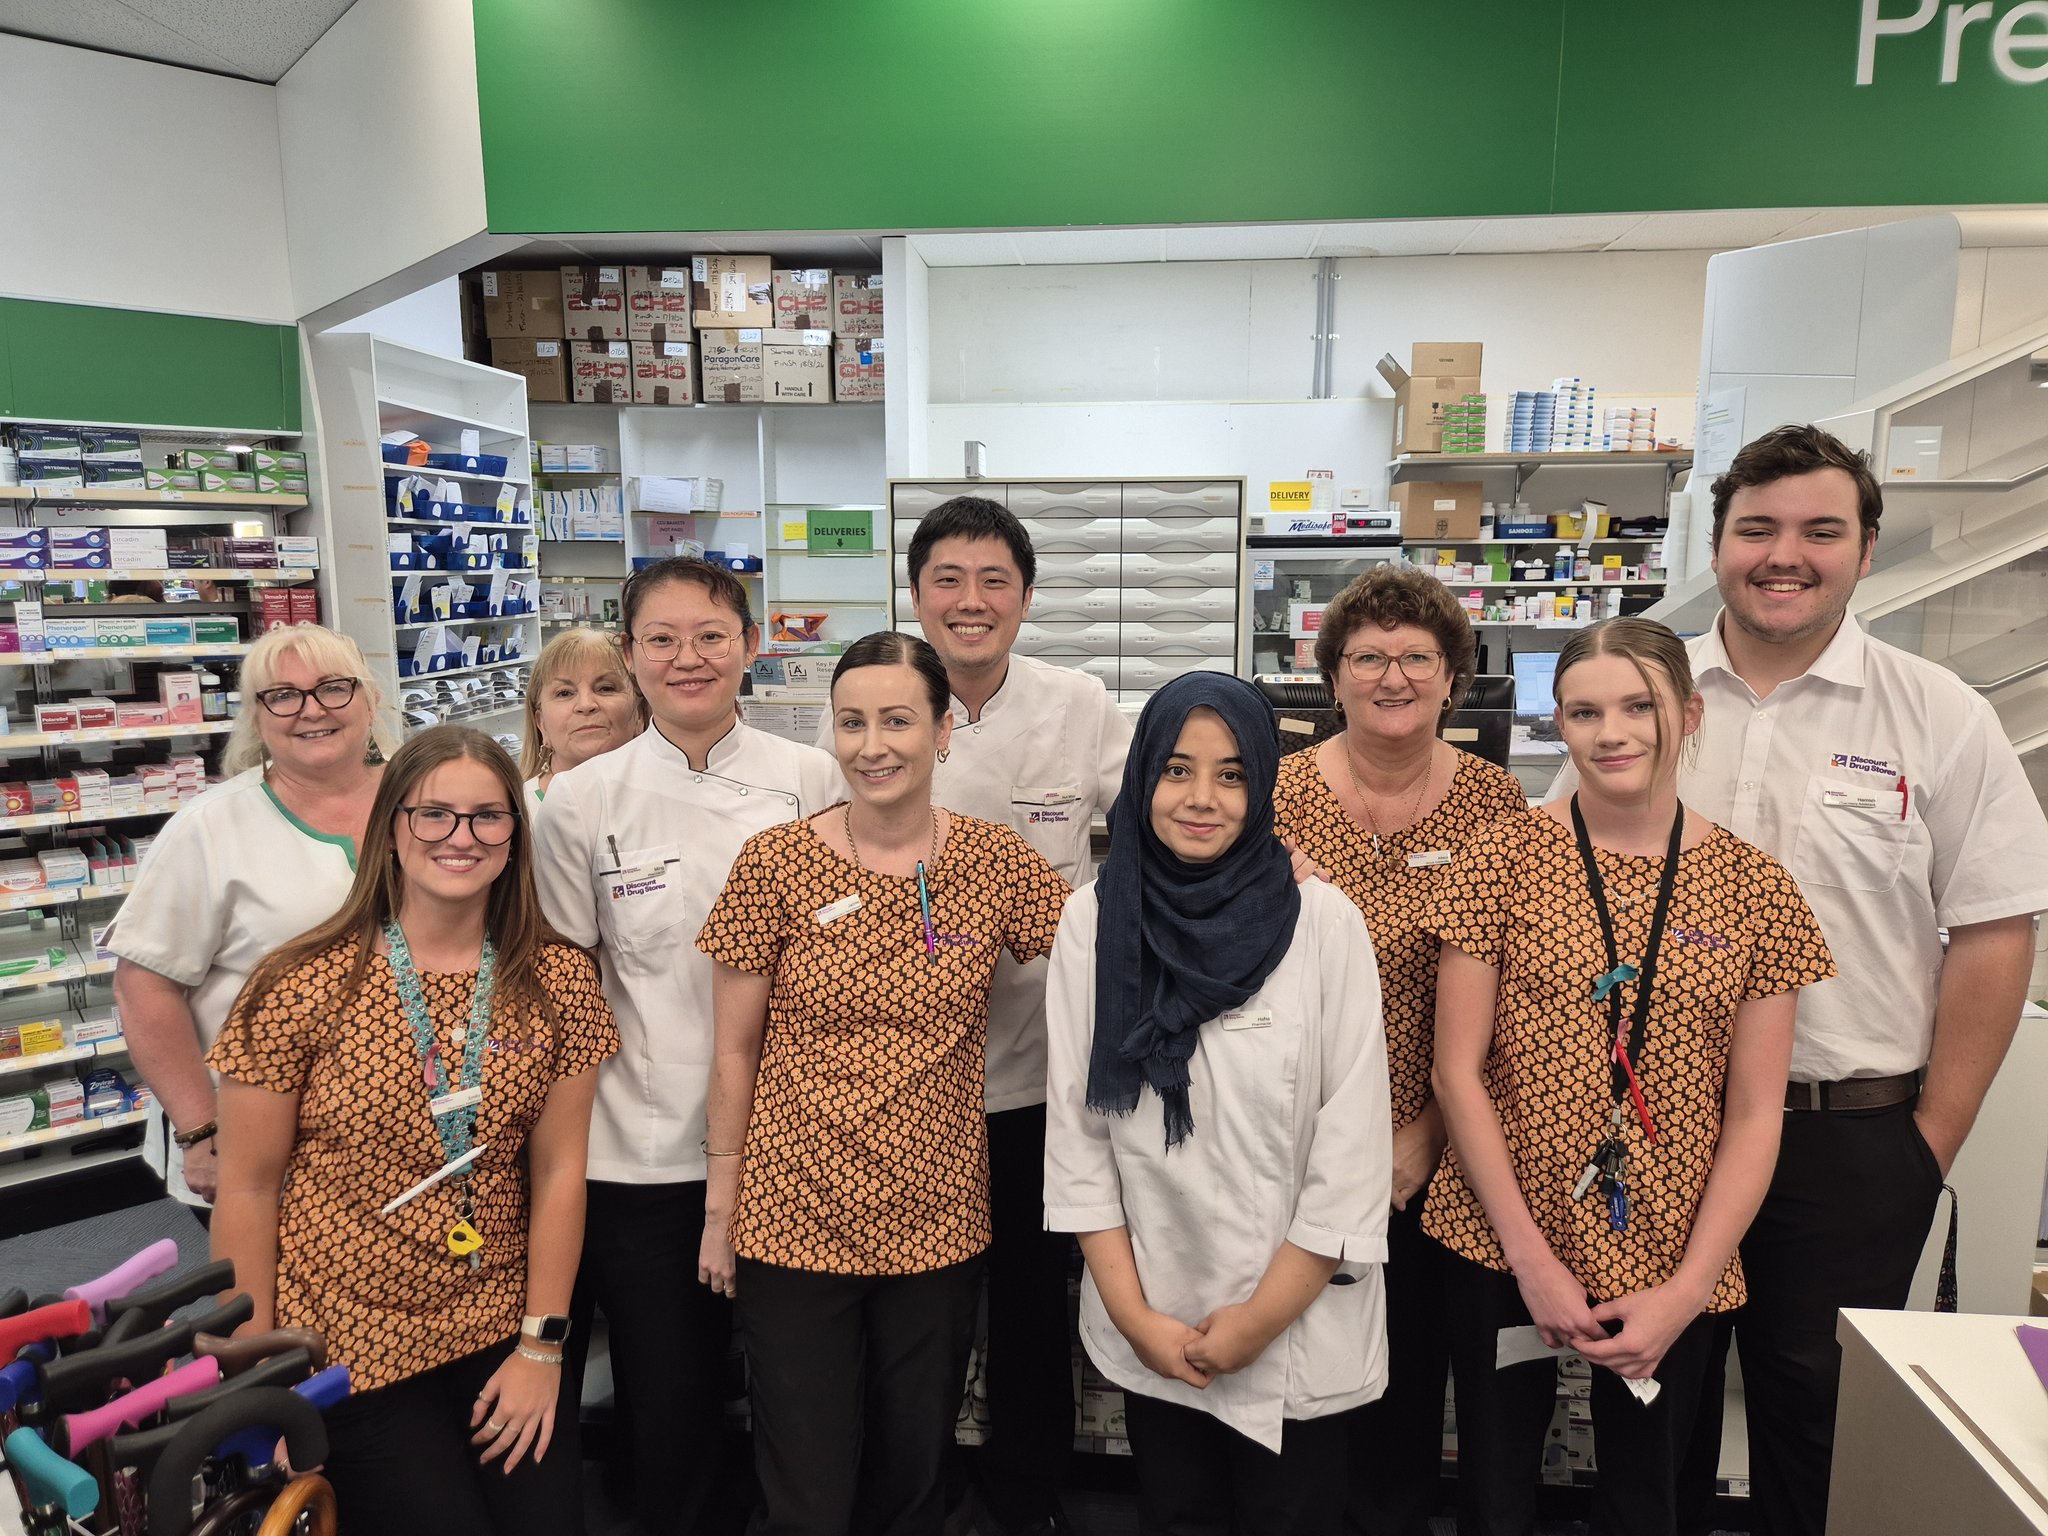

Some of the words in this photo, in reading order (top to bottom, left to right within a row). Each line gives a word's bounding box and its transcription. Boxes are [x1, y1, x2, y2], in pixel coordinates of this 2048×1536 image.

[1856, 0, 2048, 84] Pre
[630, 294, 686, 312] CH2
[777, 295, 827, 312] CH2
[839, 300, 883, 316] CH2
[704, 355, 760, 365] ParagonCare
[636, 364, 688, 381] CH2
[839, 364, 884, 379] CH2
[1270, 491, 1310, 499] DELIVERY
[814, 527, 866, 536] DELIVERIES
[1288, 520, 1332, 532] Medisafe
[46, 624, 86, 632] Phenergan
[1850, 755, 1888, 767] Discount
[1849, 763, 1870, 772] Drug
[1871, 766, 1897, 776] Stores
[626, 879, 656, 890] Discount
[627, 888, 645, 896] Drug
[645, 883, 666, 893] Stores
[89, 1079, 116, 1090] Zovirax
